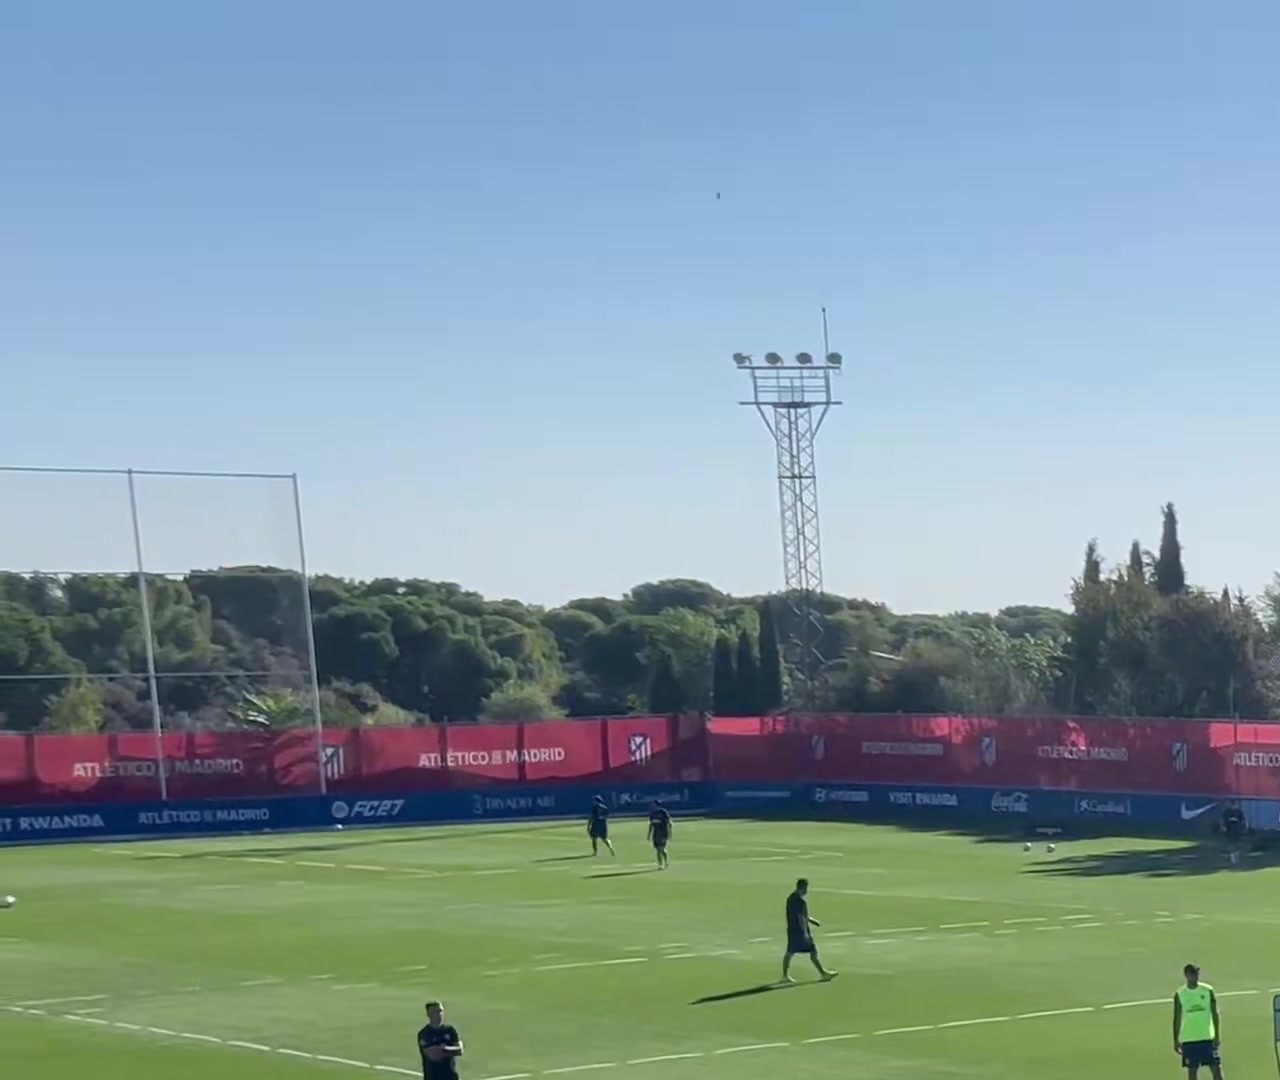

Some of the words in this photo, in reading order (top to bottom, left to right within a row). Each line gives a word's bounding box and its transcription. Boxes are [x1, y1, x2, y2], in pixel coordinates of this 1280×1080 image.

[506, 748, 565, 763] MADRID
[175, 759, 243, 774] MADRID
[20, 813, 105, 831] RWANDA
